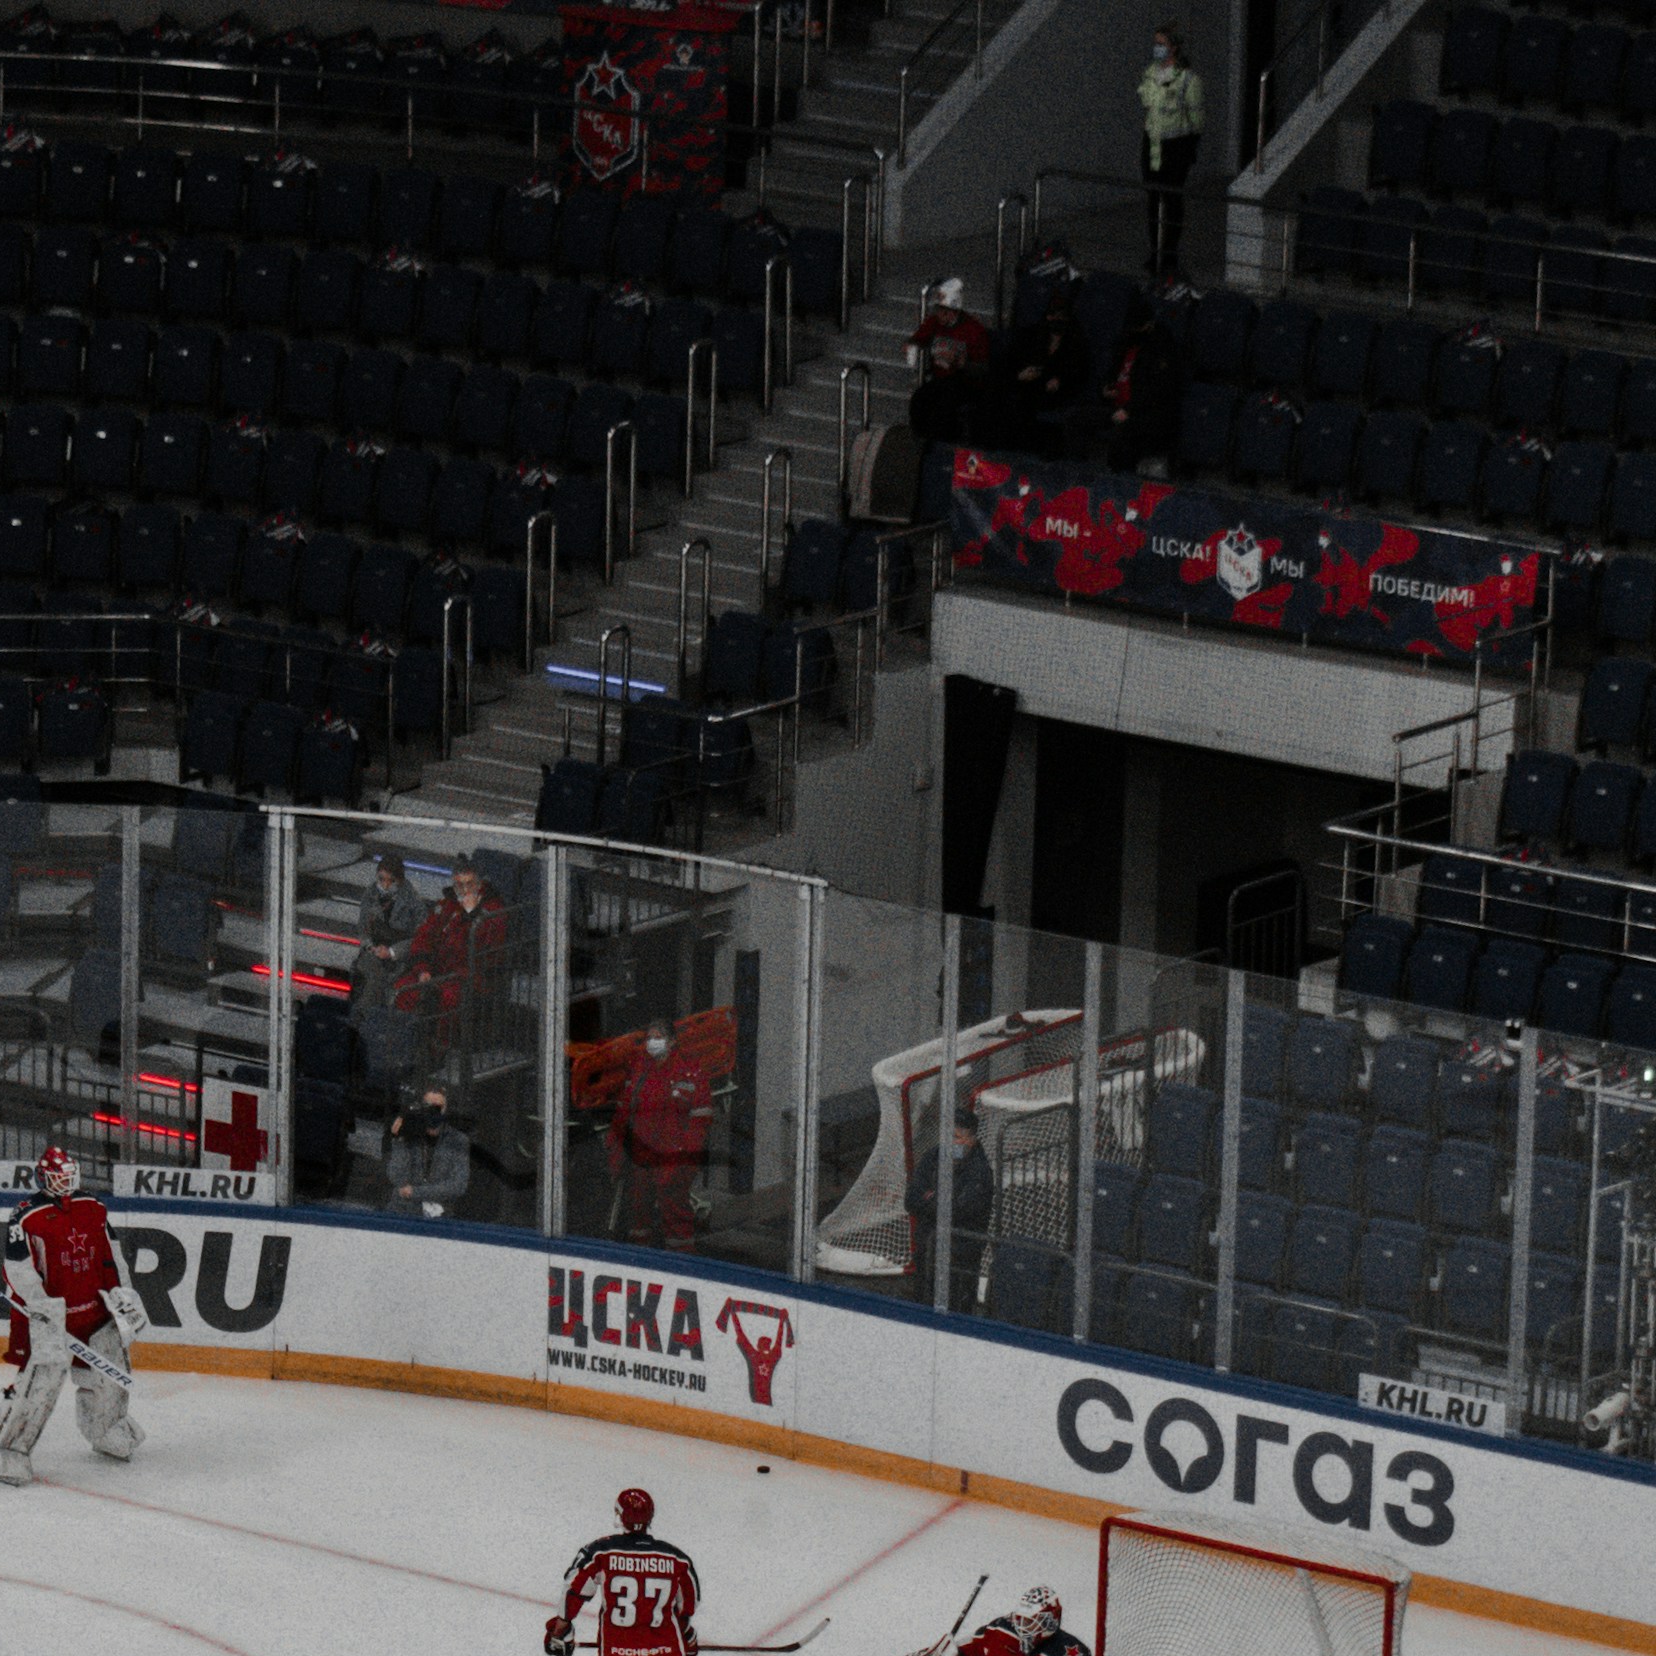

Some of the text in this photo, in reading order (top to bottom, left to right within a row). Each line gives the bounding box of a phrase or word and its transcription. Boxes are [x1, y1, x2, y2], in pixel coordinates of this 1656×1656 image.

[1046, 517, 1079, 539] МЫ
[1152, 536, 1211, 562] ЦСКА!
[1270, 555, 1305, 579] МЫ
[1369, 573, 1476, 609] ПОБЕДИМ!
[134, 1170, 257, 1200] KHL.RU
[548, 1266, 705, 1362] ЦСКА
[1376, 1381, 1488, 1428] KHL.RU
[608, 1554, 675, 1575] ROBINSON
[610, 1574, 673, 1629] 37
